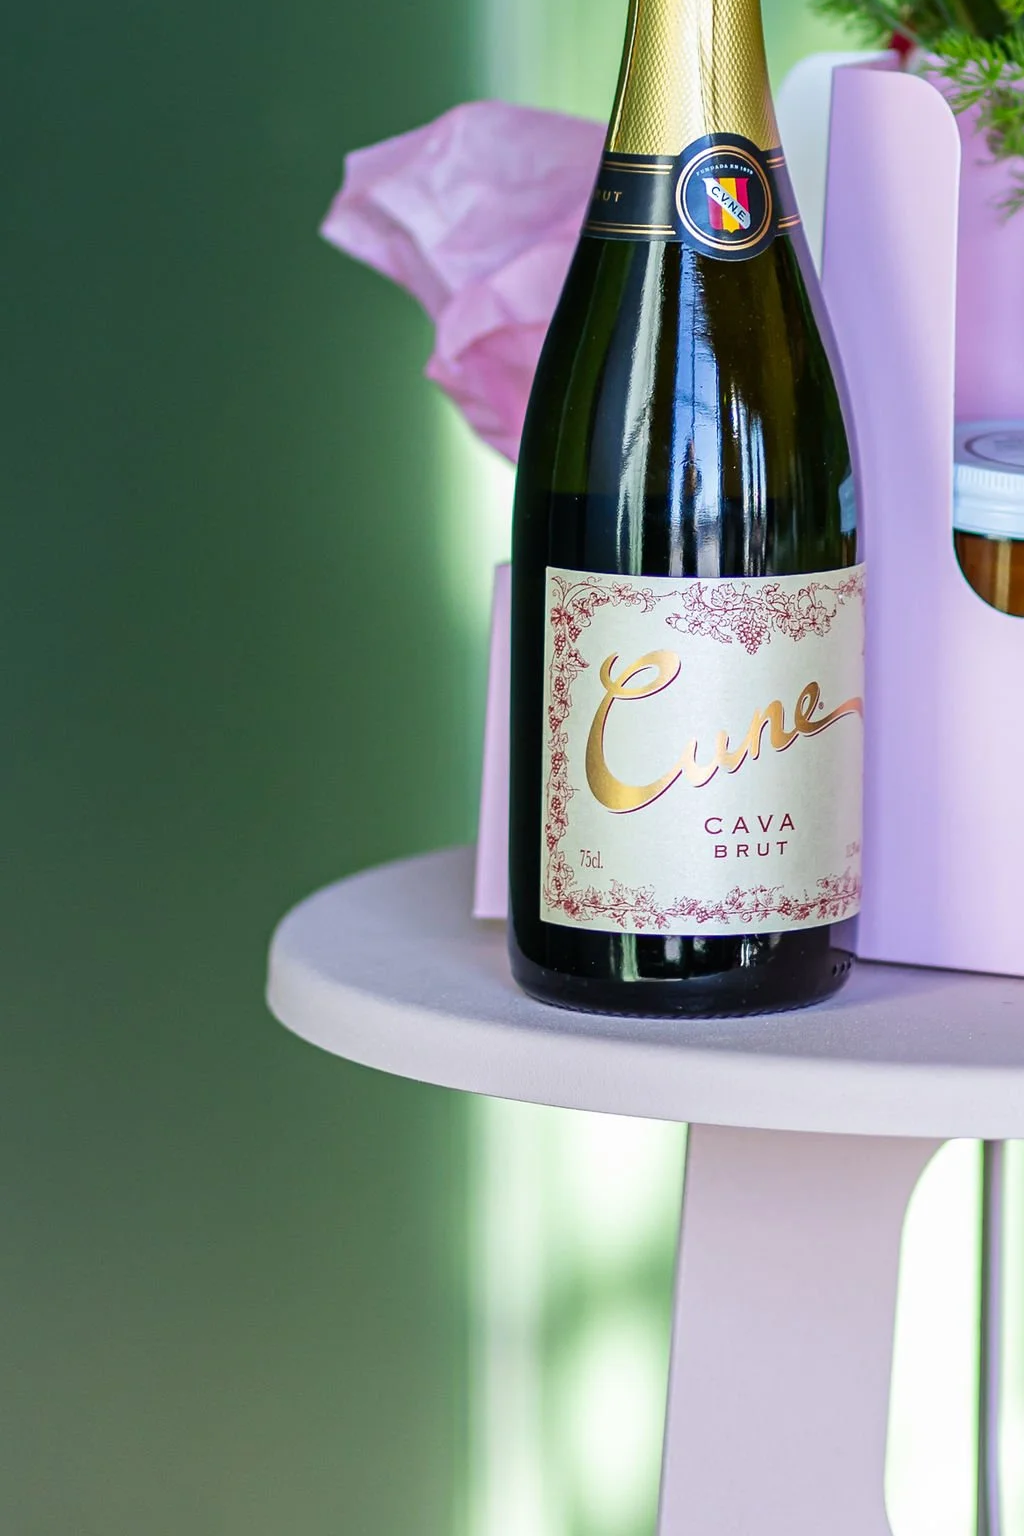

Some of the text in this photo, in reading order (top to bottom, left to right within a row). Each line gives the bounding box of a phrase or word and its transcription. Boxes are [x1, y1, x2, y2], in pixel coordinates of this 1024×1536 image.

[696, 164, 728, 176] FUNDADA
[585, 649, 863, 814] Cune
[704, 813, 796, 835] CAVA
[713, 841, 788, 859] BRUT
